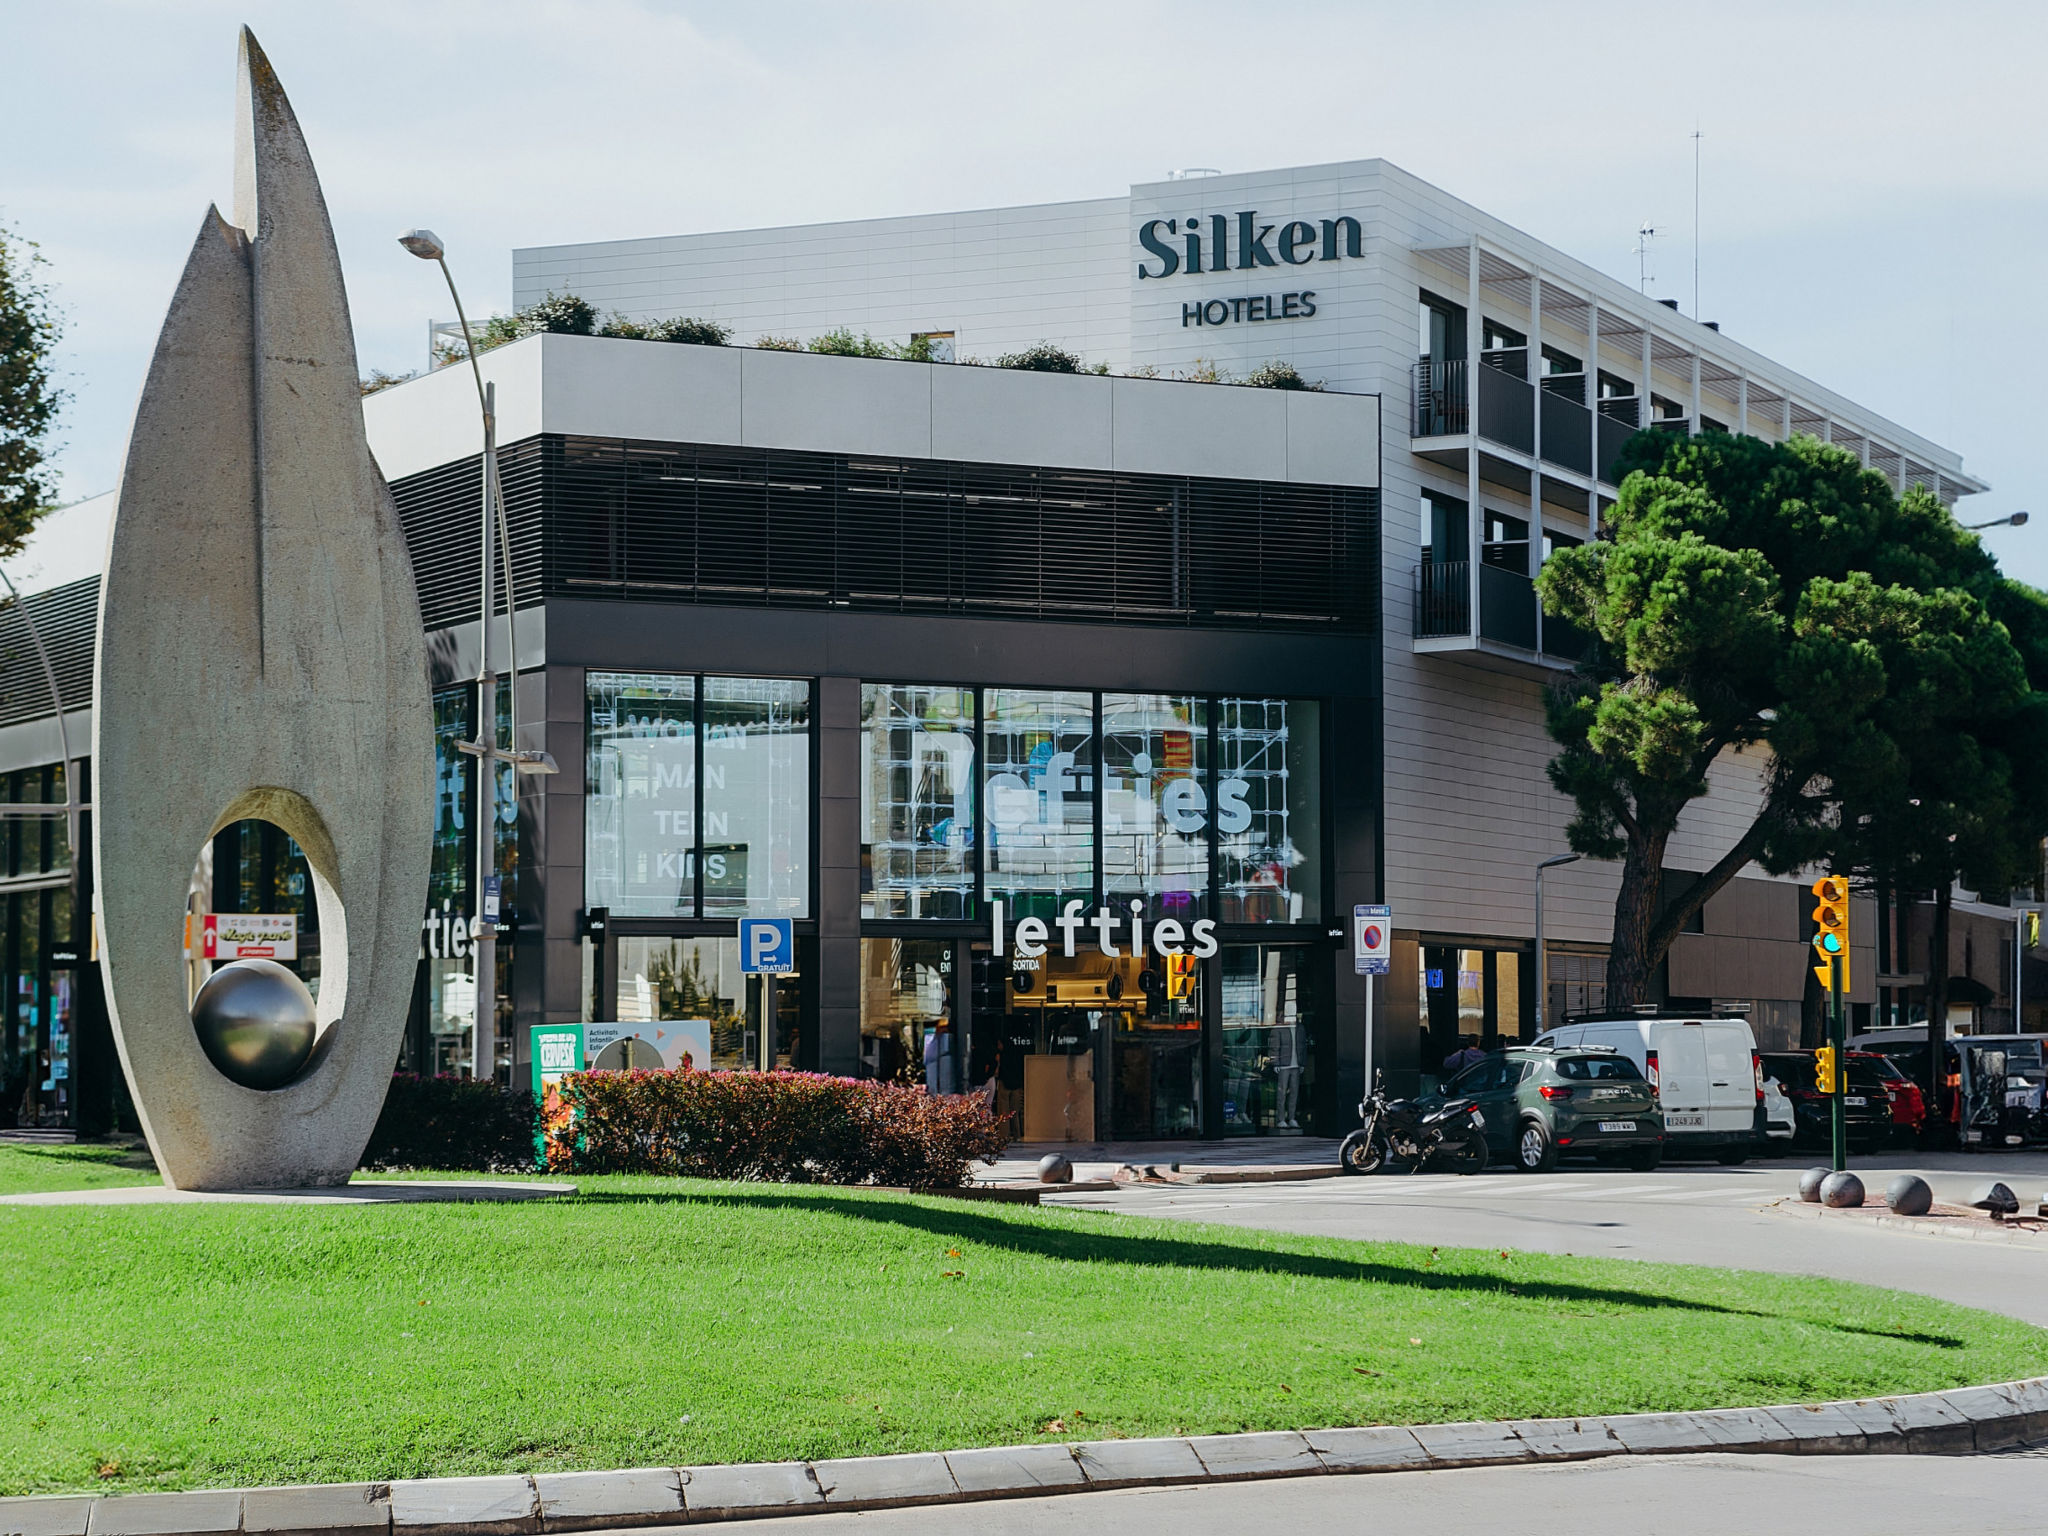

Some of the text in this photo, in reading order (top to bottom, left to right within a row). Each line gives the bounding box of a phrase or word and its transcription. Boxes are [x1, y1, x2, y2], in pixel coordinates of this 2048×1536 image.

[1138, 210, 1365, 280] Silken
[1182, 291, 1316, 327] HOTELES
[656, 763, 725, 790] MAN
[953, 747, 1252, 834] lefties
[657, 853, 726, 879] KIDS
[751, 924, 782, 967] P
[992, 899, 1218, 958] lefties
[1012, 959, 1040, 971] SORTIDA
